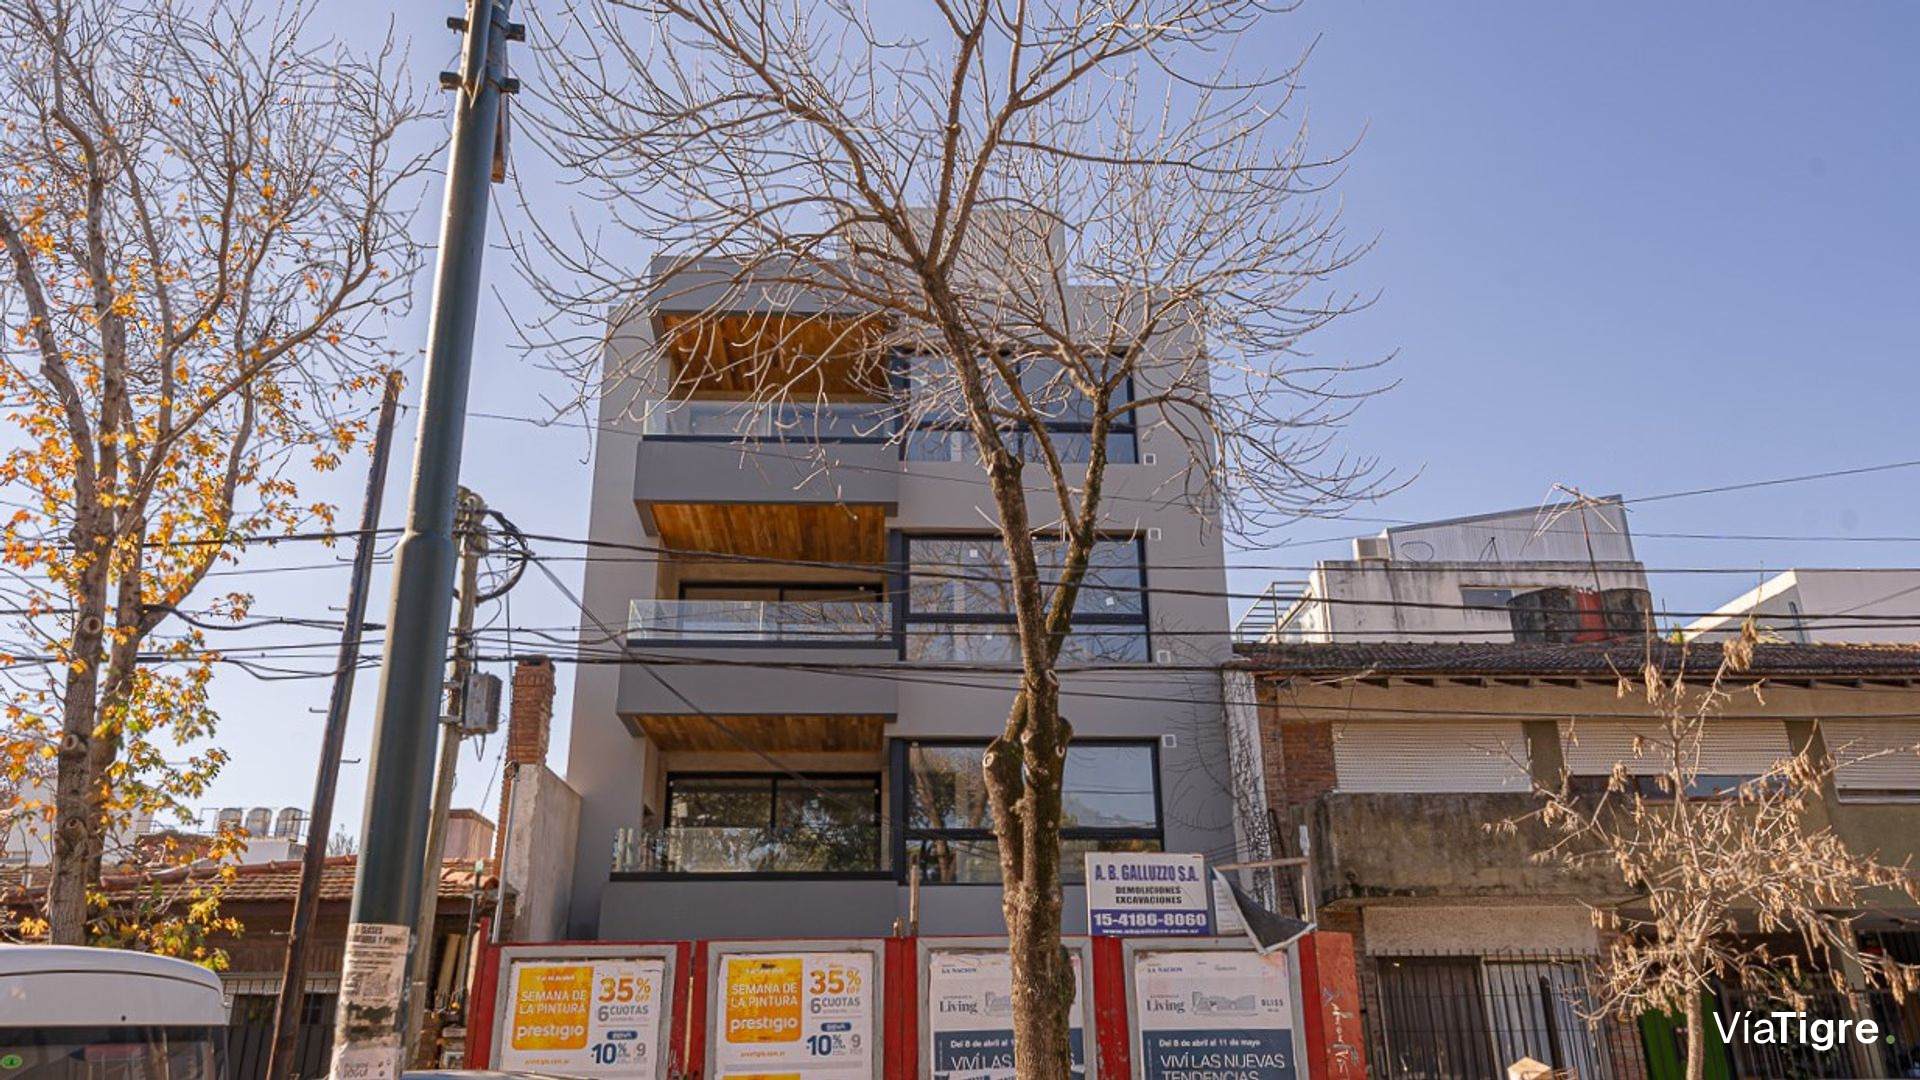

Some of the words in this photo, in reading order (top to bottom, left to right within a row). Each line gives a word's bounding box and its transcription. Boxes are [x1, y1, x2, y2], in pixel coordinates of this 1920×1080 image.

[1095, 865, 1105, 880] A.
[1108, 865, 1119, 880] B.
[1121, 865, 1176, 881] GALLUZZO
[1178, 866, 1199, 882] S.A.
[1115, 886, 1182, 895] DEMOLICIONES
[1115, 896, 1182, 904] EXCAVACIONES
[1094, 912, 1207, 927] 15-4186-8060
[732, 984, 780, 995] SEMANA
[783, 982, 798, 993] DE
[521, 991, 569, 1002] SEMANA
[572, 990, 587, 1000] DE
[731, 997, 745, 1008] LA
[748, 995, 798, 1007] PINTURA
[519, 1003, 534, 1014] LA
[537, 1003, 586, 1014] PINTURA
[810, 998, 821, 1014] 6
[822, 997, 860, 1008] CUOTAS
[939, 1001, 978, 1014] Living
[1146, 1000, 1185, 1013] Living
[598, 1006, 609, 1022] 6
[610, 1005, 649, 1015] CUOTAS
[730, 1016, 799, 1034] prestigio
[516, 1024, 585, 1041] prestigio
[851, 1033, 861, 1049] 9
[951, 1040, 963, 1048] Del
[983, 1040, 1000, 1048] abril
[1159, 1039, 1171, 1047] Del
[1192, 1039, 1208, 1047] abril
[1219, 1039, 1227, 1047] 11
[1229, 1039, 1239, 1047] de
[1240, 1040, 1261, 1048] mayo
[636, 1042, 647, 1057] 9
[1160, 1052, 1189, 1069] VIVÍ
[1191, 1055, 1221, 1069] LAS
[1224, 1054, 1285, 1069] NUEVAS
[1162, 1071, 1260, 1080] TENDENCIAS
